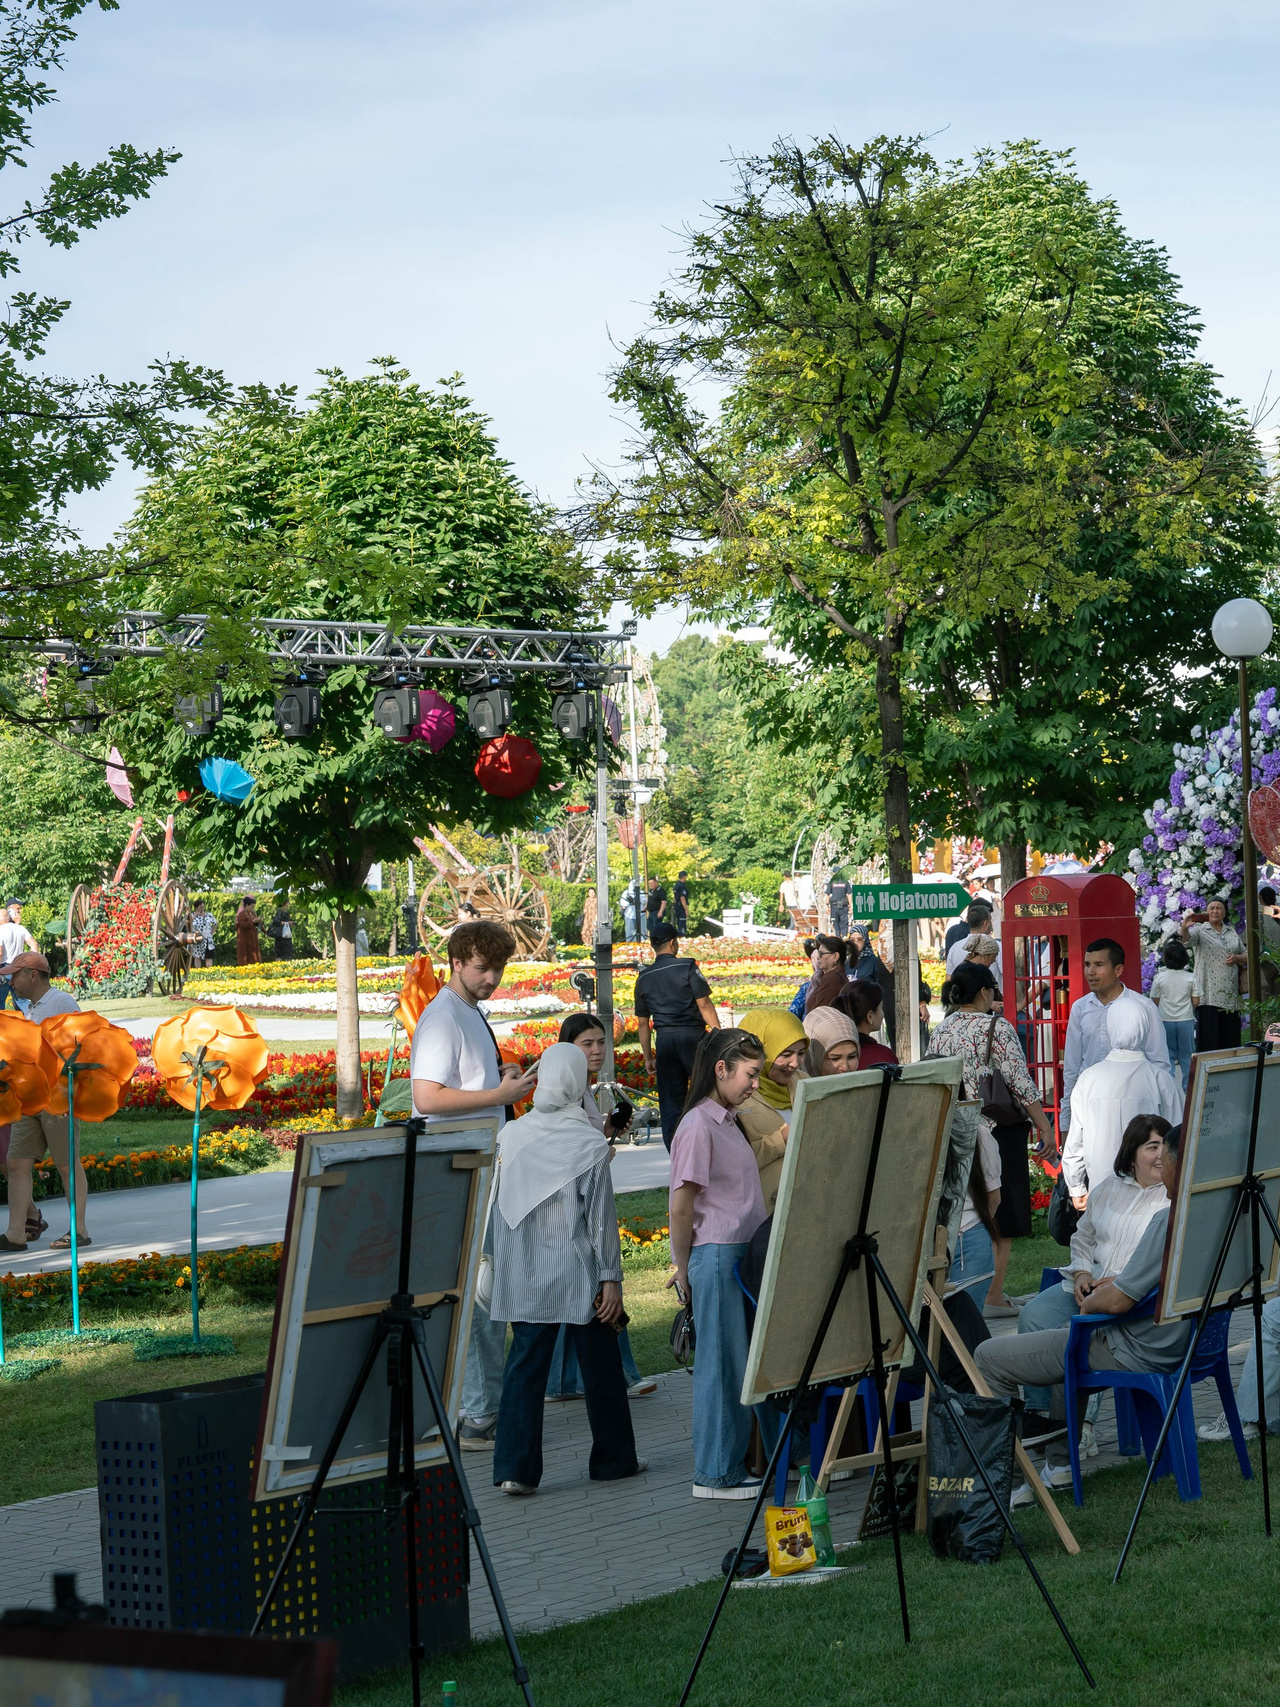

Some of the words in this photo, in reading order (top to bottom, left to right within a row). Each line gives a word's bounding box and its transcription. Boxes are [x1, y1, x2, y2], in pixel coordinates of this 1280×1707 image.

[879, 892, 957, 913] Hojatxona
[177, 1449, 229, 1468] PLASTIC
[928, 1476, 975, 1492] BAZAR
